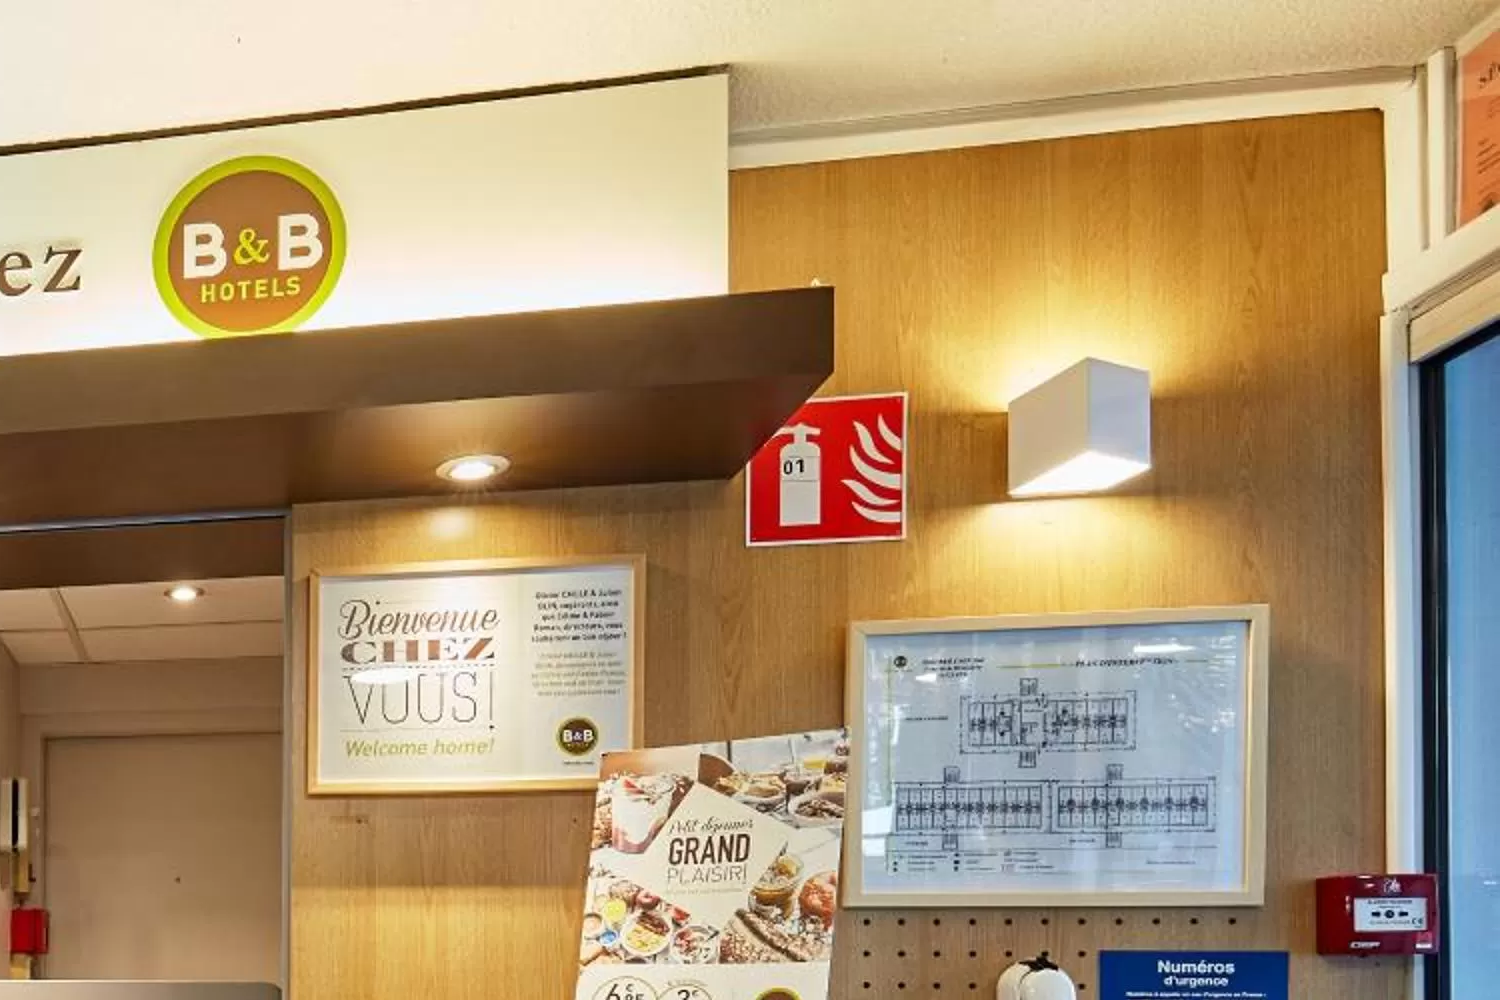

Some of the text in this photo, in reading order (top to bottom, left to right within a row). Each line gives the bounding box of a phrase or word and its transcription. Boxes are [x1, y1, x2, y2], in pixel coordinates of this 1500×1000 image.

[182, 213, 324, 280] B&B
[200, 276, 302, 304] HOTELS
[783, 459, 805, 475] 01
[338, 599, 500, 640] Bienvenue
[341, 636, 495, 664] CHEZ
[345, 737, 495, 757] Welcome home!
[669, 833, 751, 865] GRAND
[667, 864, 748, 885] PLAISIR!
[1157, 959, 1235, 973] Numéros
[1163, 975, 1229, 988] d'urgence
